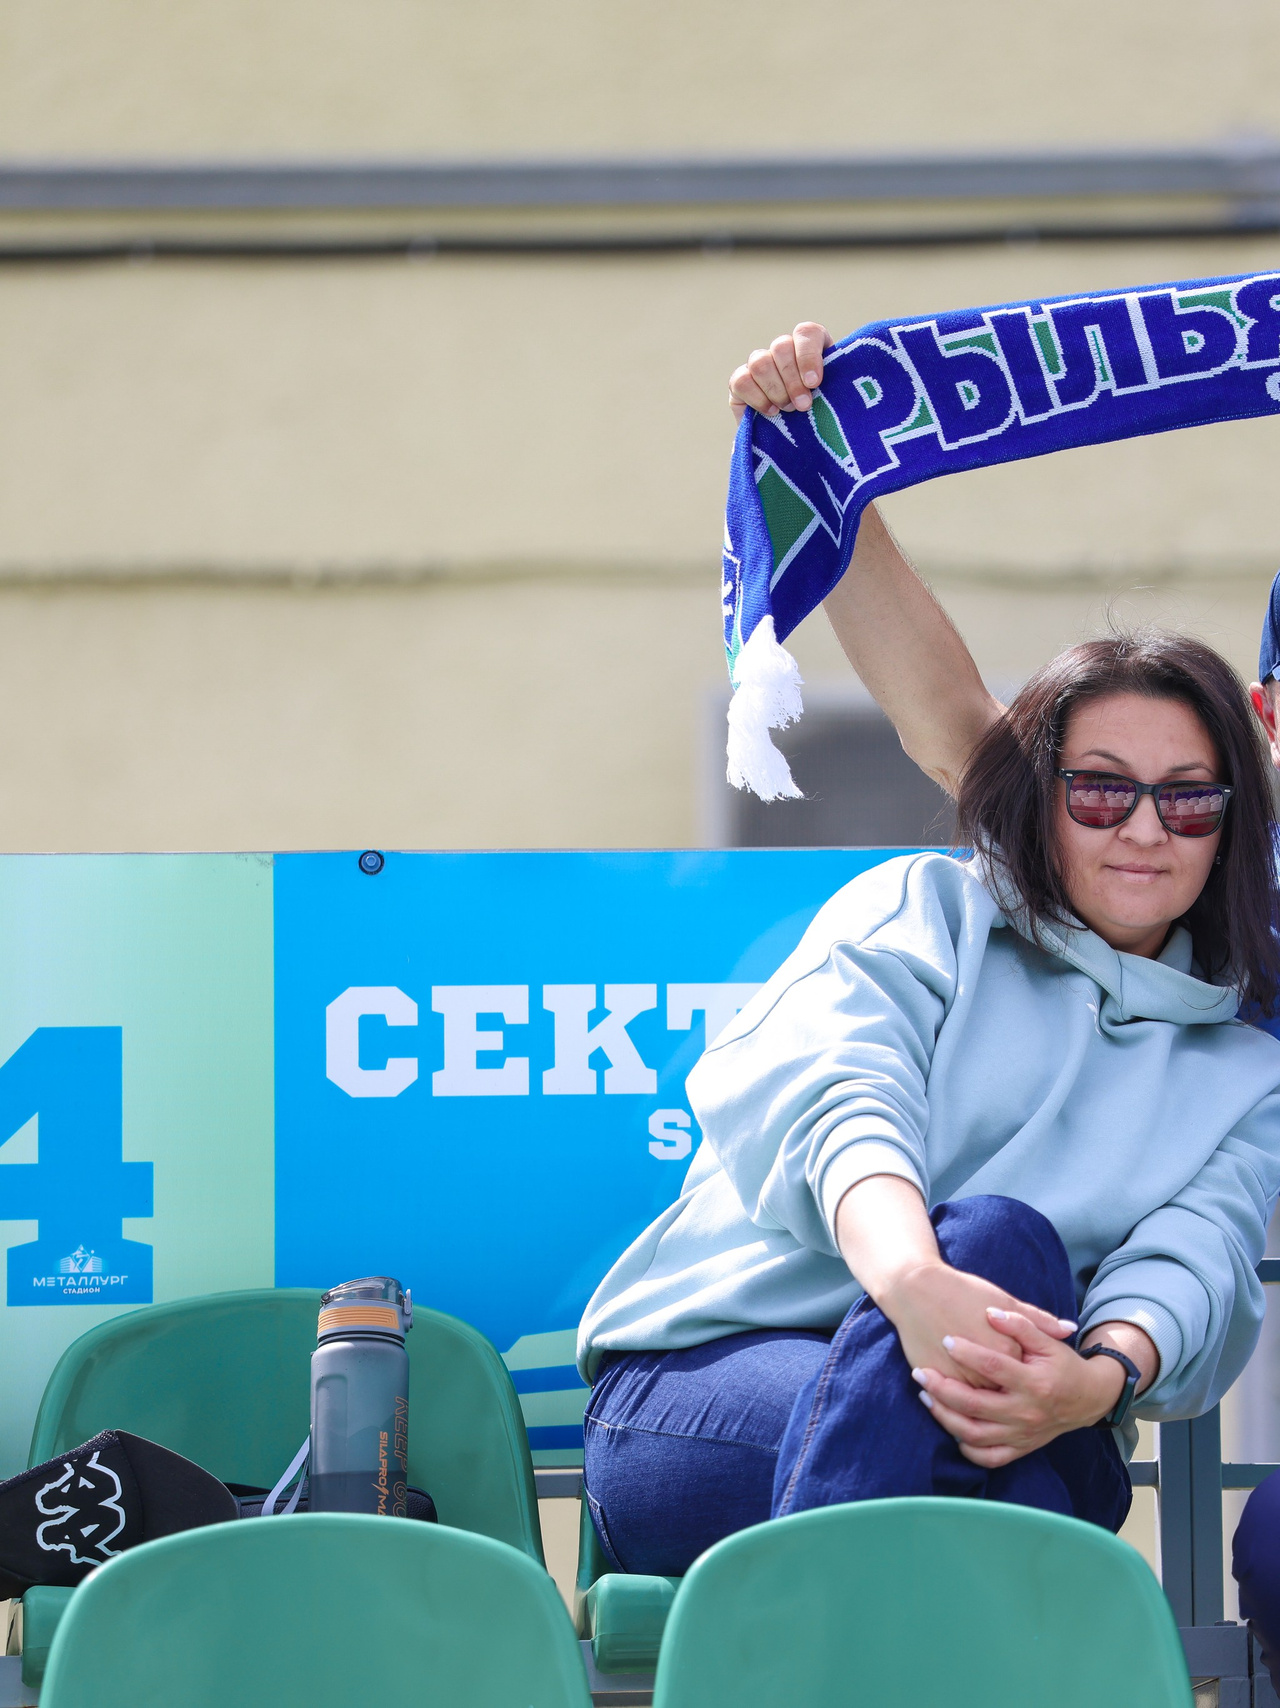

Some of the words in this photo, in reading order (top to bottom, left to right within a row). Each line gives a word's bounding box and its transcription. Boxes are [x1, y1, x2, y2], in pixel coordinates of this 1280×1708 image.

[325, 983, 767, 1098] СЕКТ
[33, 1275, 128, 1287] МЕТАЛЛУРГ
[62, 1287, 101, 1295] СТАДИОН
